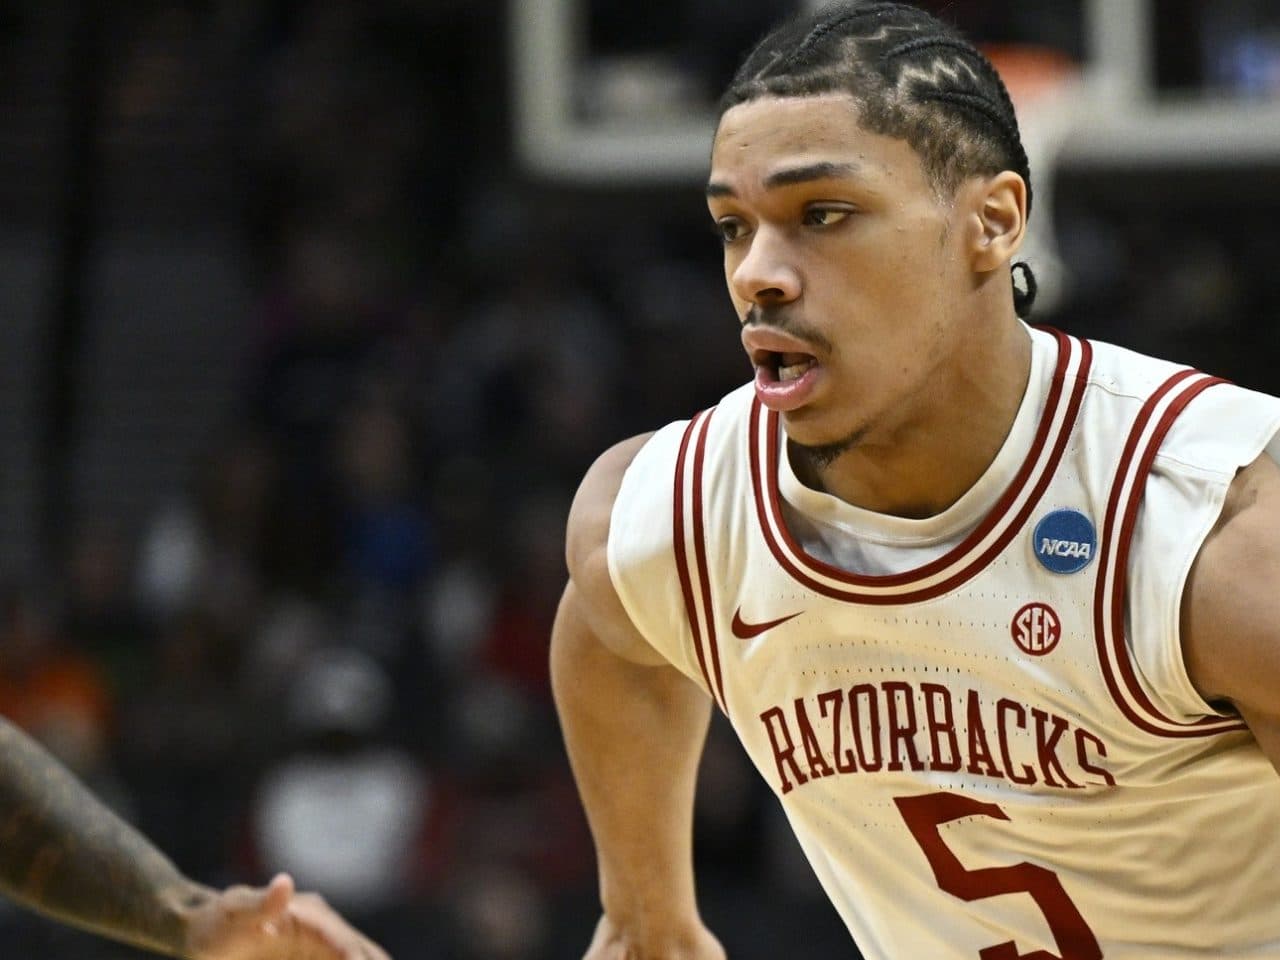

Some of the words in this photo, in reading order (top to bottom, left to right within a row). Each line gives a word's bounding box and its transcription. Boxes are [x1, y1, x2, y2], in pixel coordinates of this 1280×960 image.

[1040, 537, 1091, 560] NCAA
[1016, 607, 1056, 651] SEC
[760, 681, 1117, 796] RAZORBACKS
